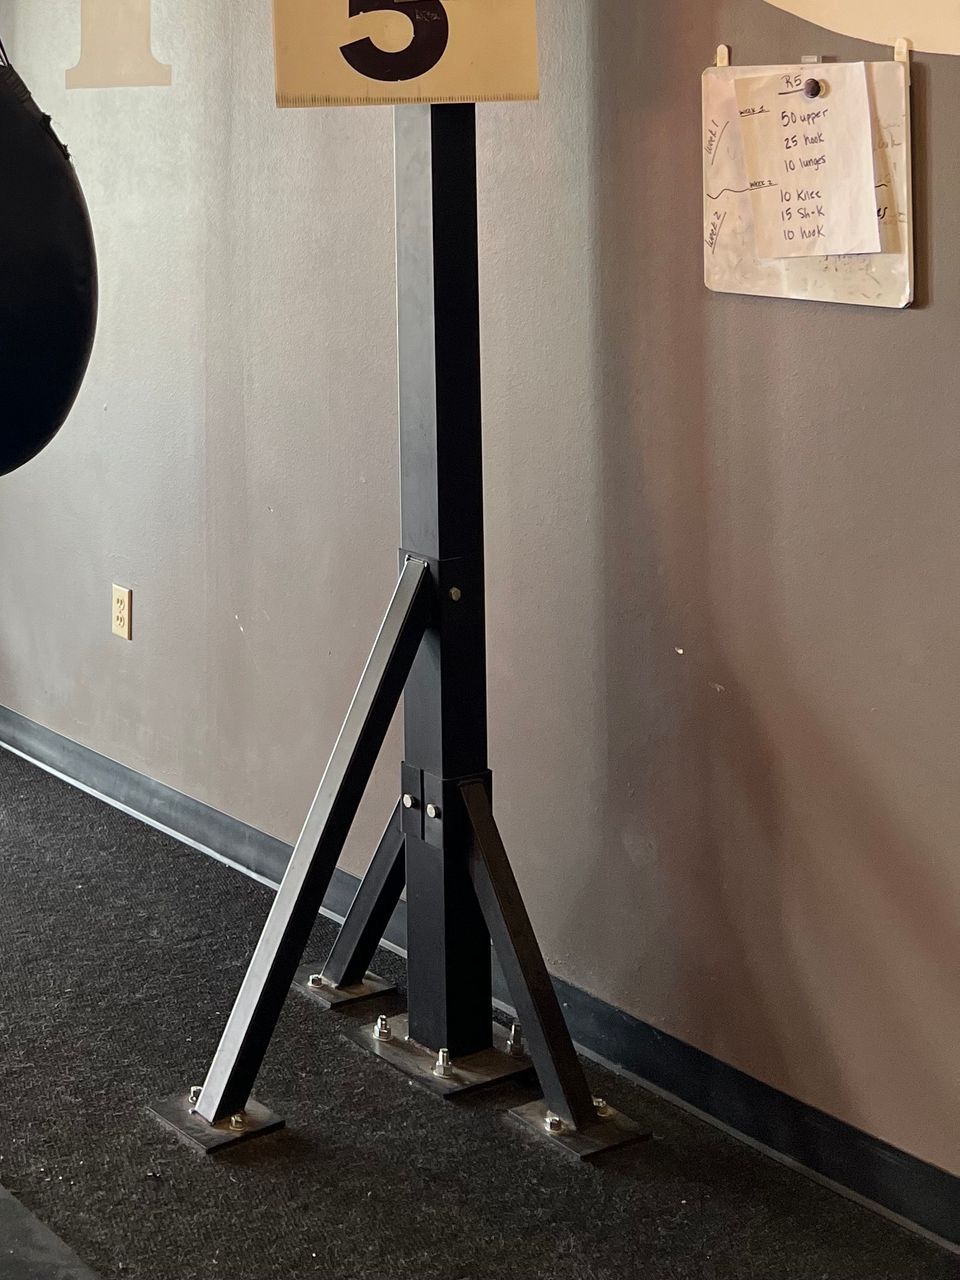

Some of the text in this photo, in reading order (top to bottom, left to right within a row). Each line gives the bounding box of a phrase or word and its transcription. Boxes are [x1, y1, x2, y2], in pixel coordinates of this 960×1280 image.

[781, 74, 802, 89] R5
[781, 108, 829, 127] 50 upper
[784, 135, 798, 150] 25
[784, 154, 827, 173] 10 lunges
[780, 189, 792, 203] 10
[781, 207, 793, 221] 15
[783, 229, 795, 241] 10
